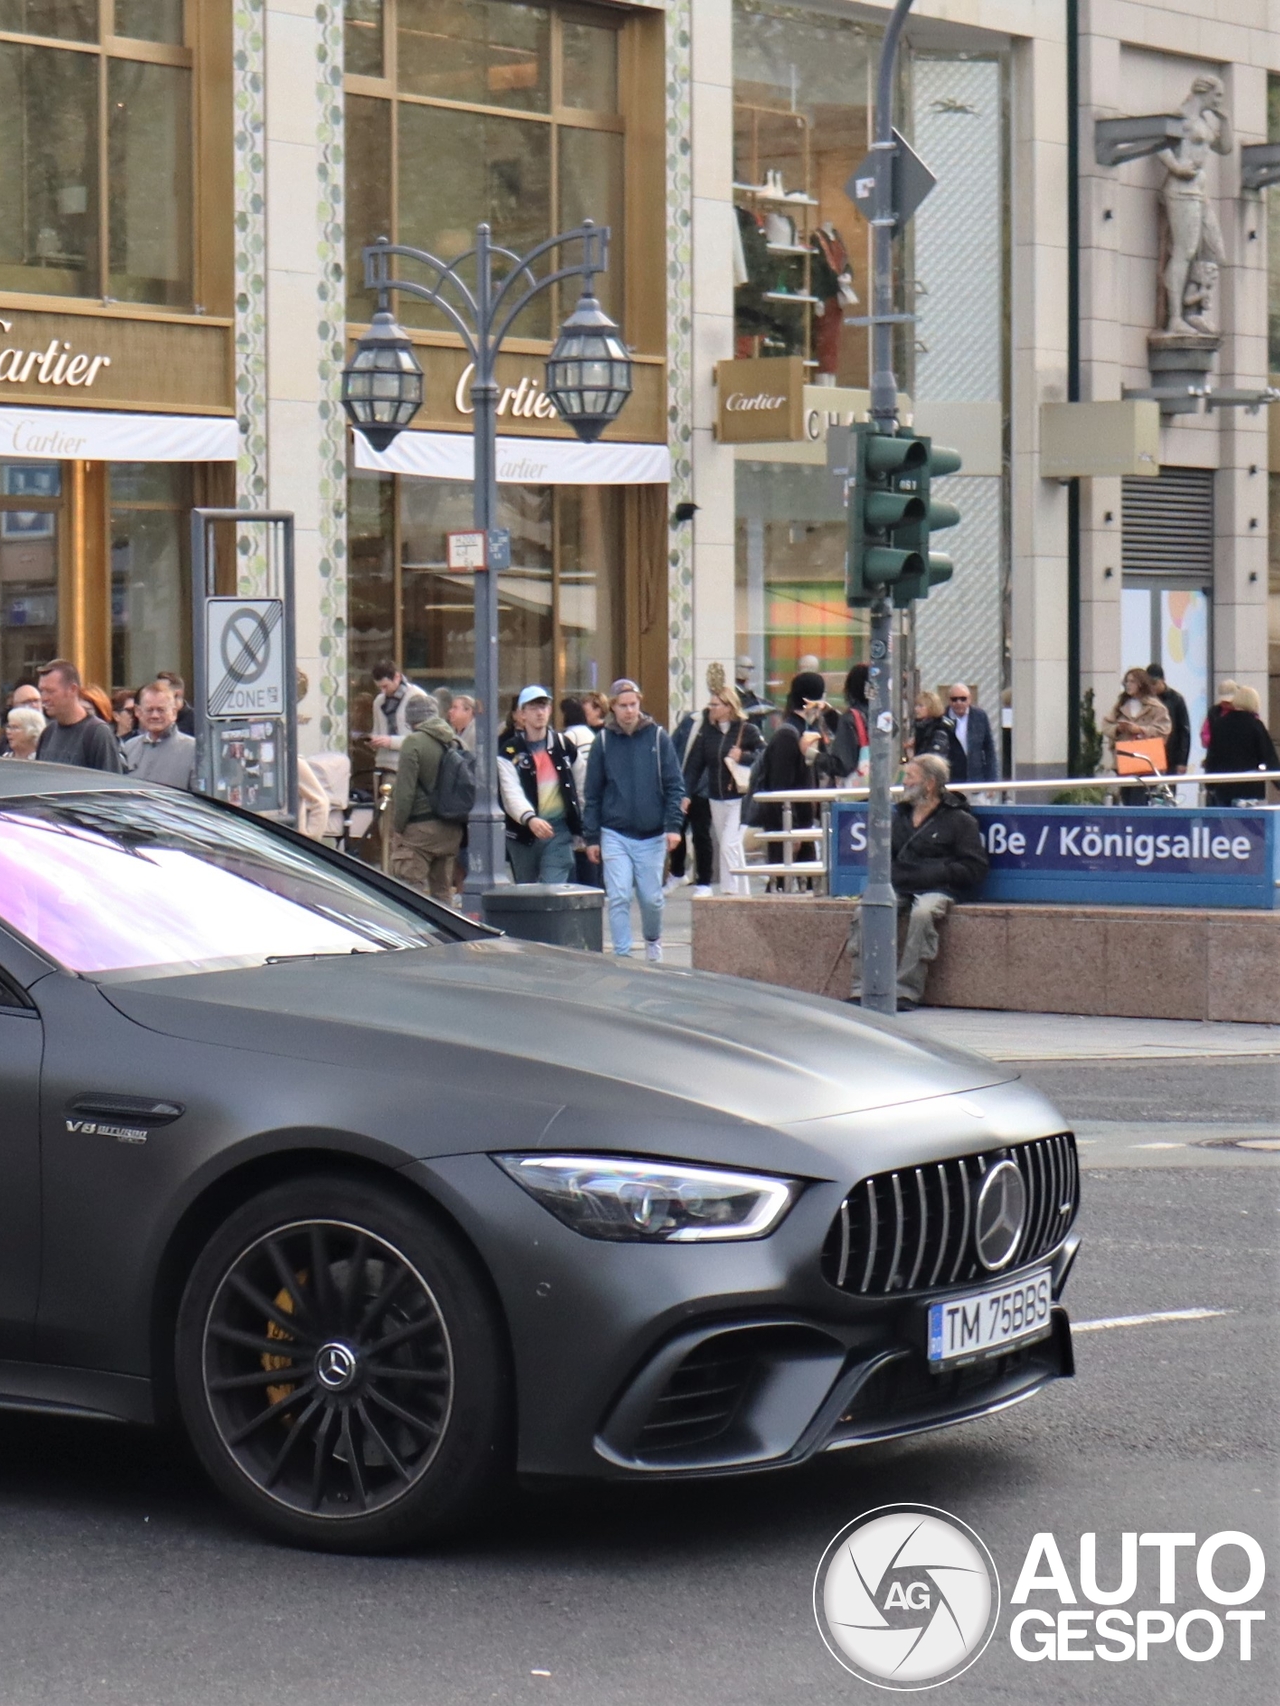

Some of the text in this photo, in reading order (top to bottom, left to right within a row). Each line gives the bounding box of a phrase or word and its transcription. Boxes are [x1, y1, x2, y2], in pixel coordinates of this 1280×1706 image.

[725, 392, 786, 412] Cartier
[12, 419, 87, 454] Cartier
[495, 449, 548, 480] artier
[227, 689, 266, 709] ZONE
[1059, 826, 1251, 867] Königsallee
[65, 1120, 97, 1134] V8
[947, 1279, 1048, 1350] TM 75BBS
